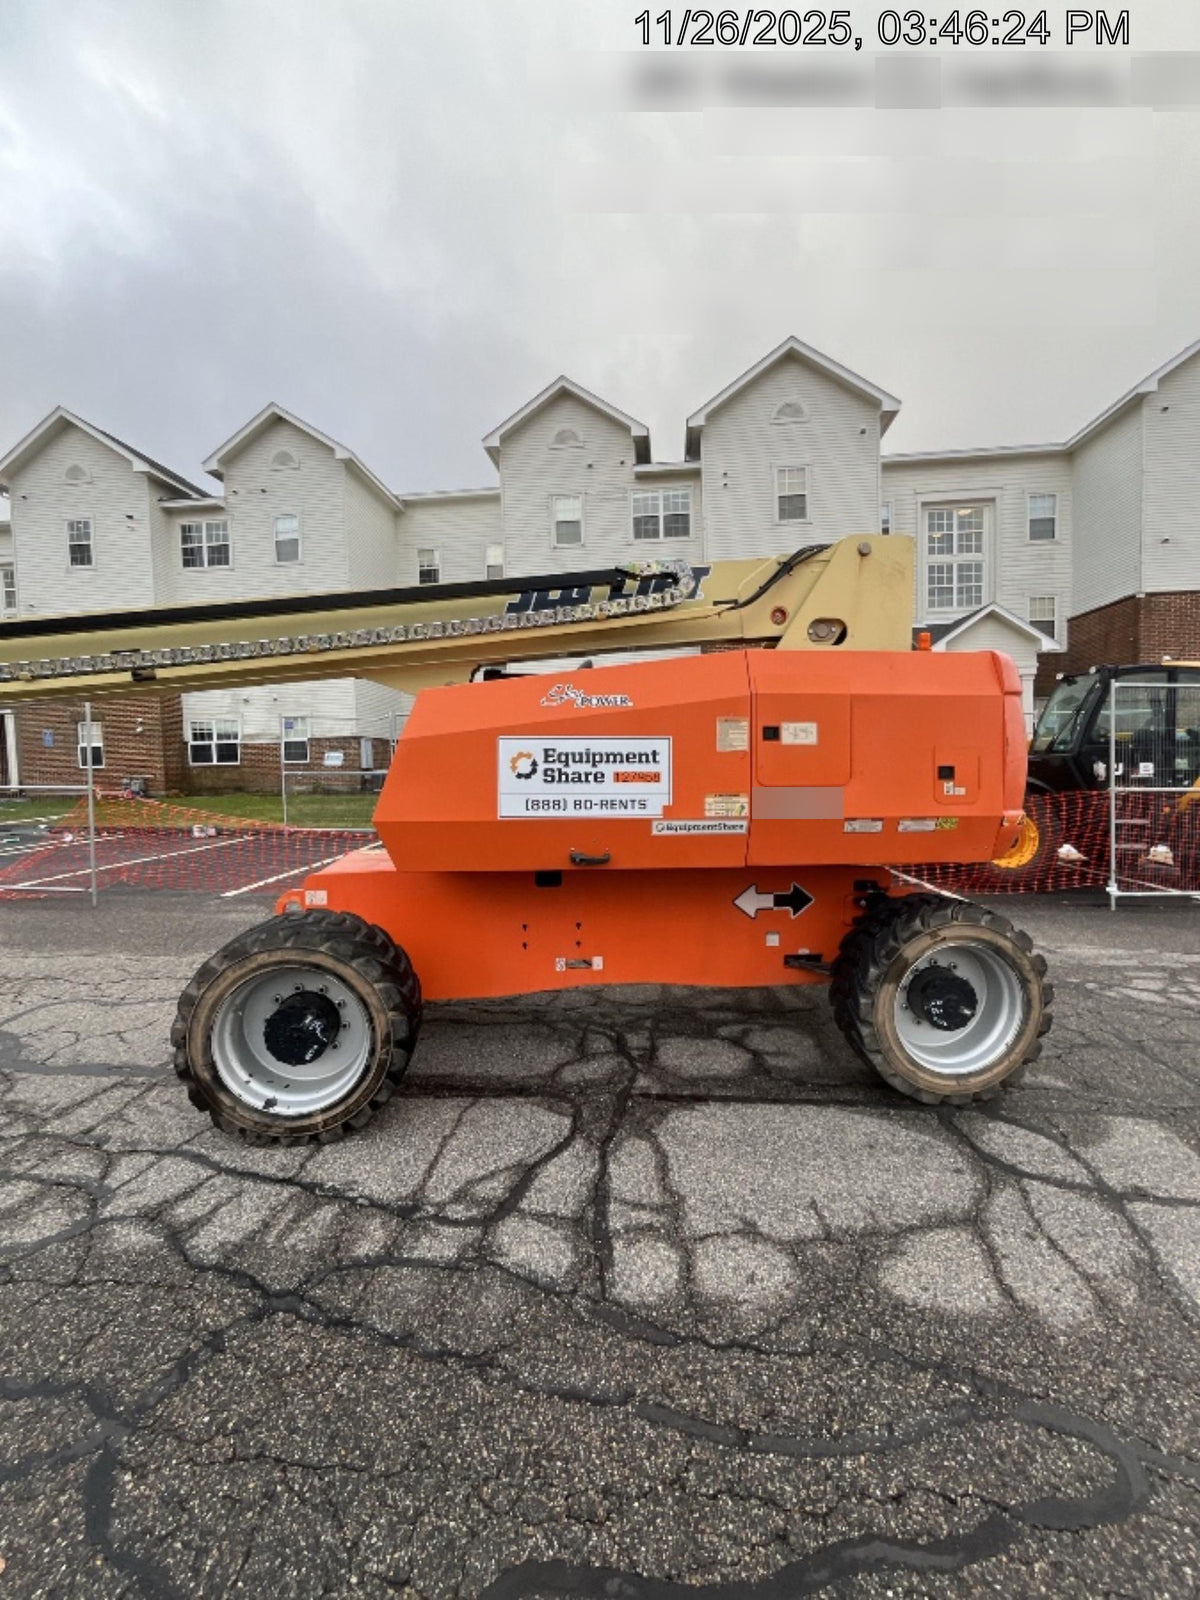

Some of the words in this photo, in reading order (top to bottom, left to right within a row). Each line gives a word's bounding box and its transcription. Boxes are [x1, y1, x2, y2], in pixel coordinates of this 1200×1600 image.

[578, 695, 630, 707] POWER
[542, 748, 660, 768] Equipment
[542, 767, 606, 784] Share
[525, 798, 568, 812] (888)
[665, 822, 745, 833] EquipmentShare
